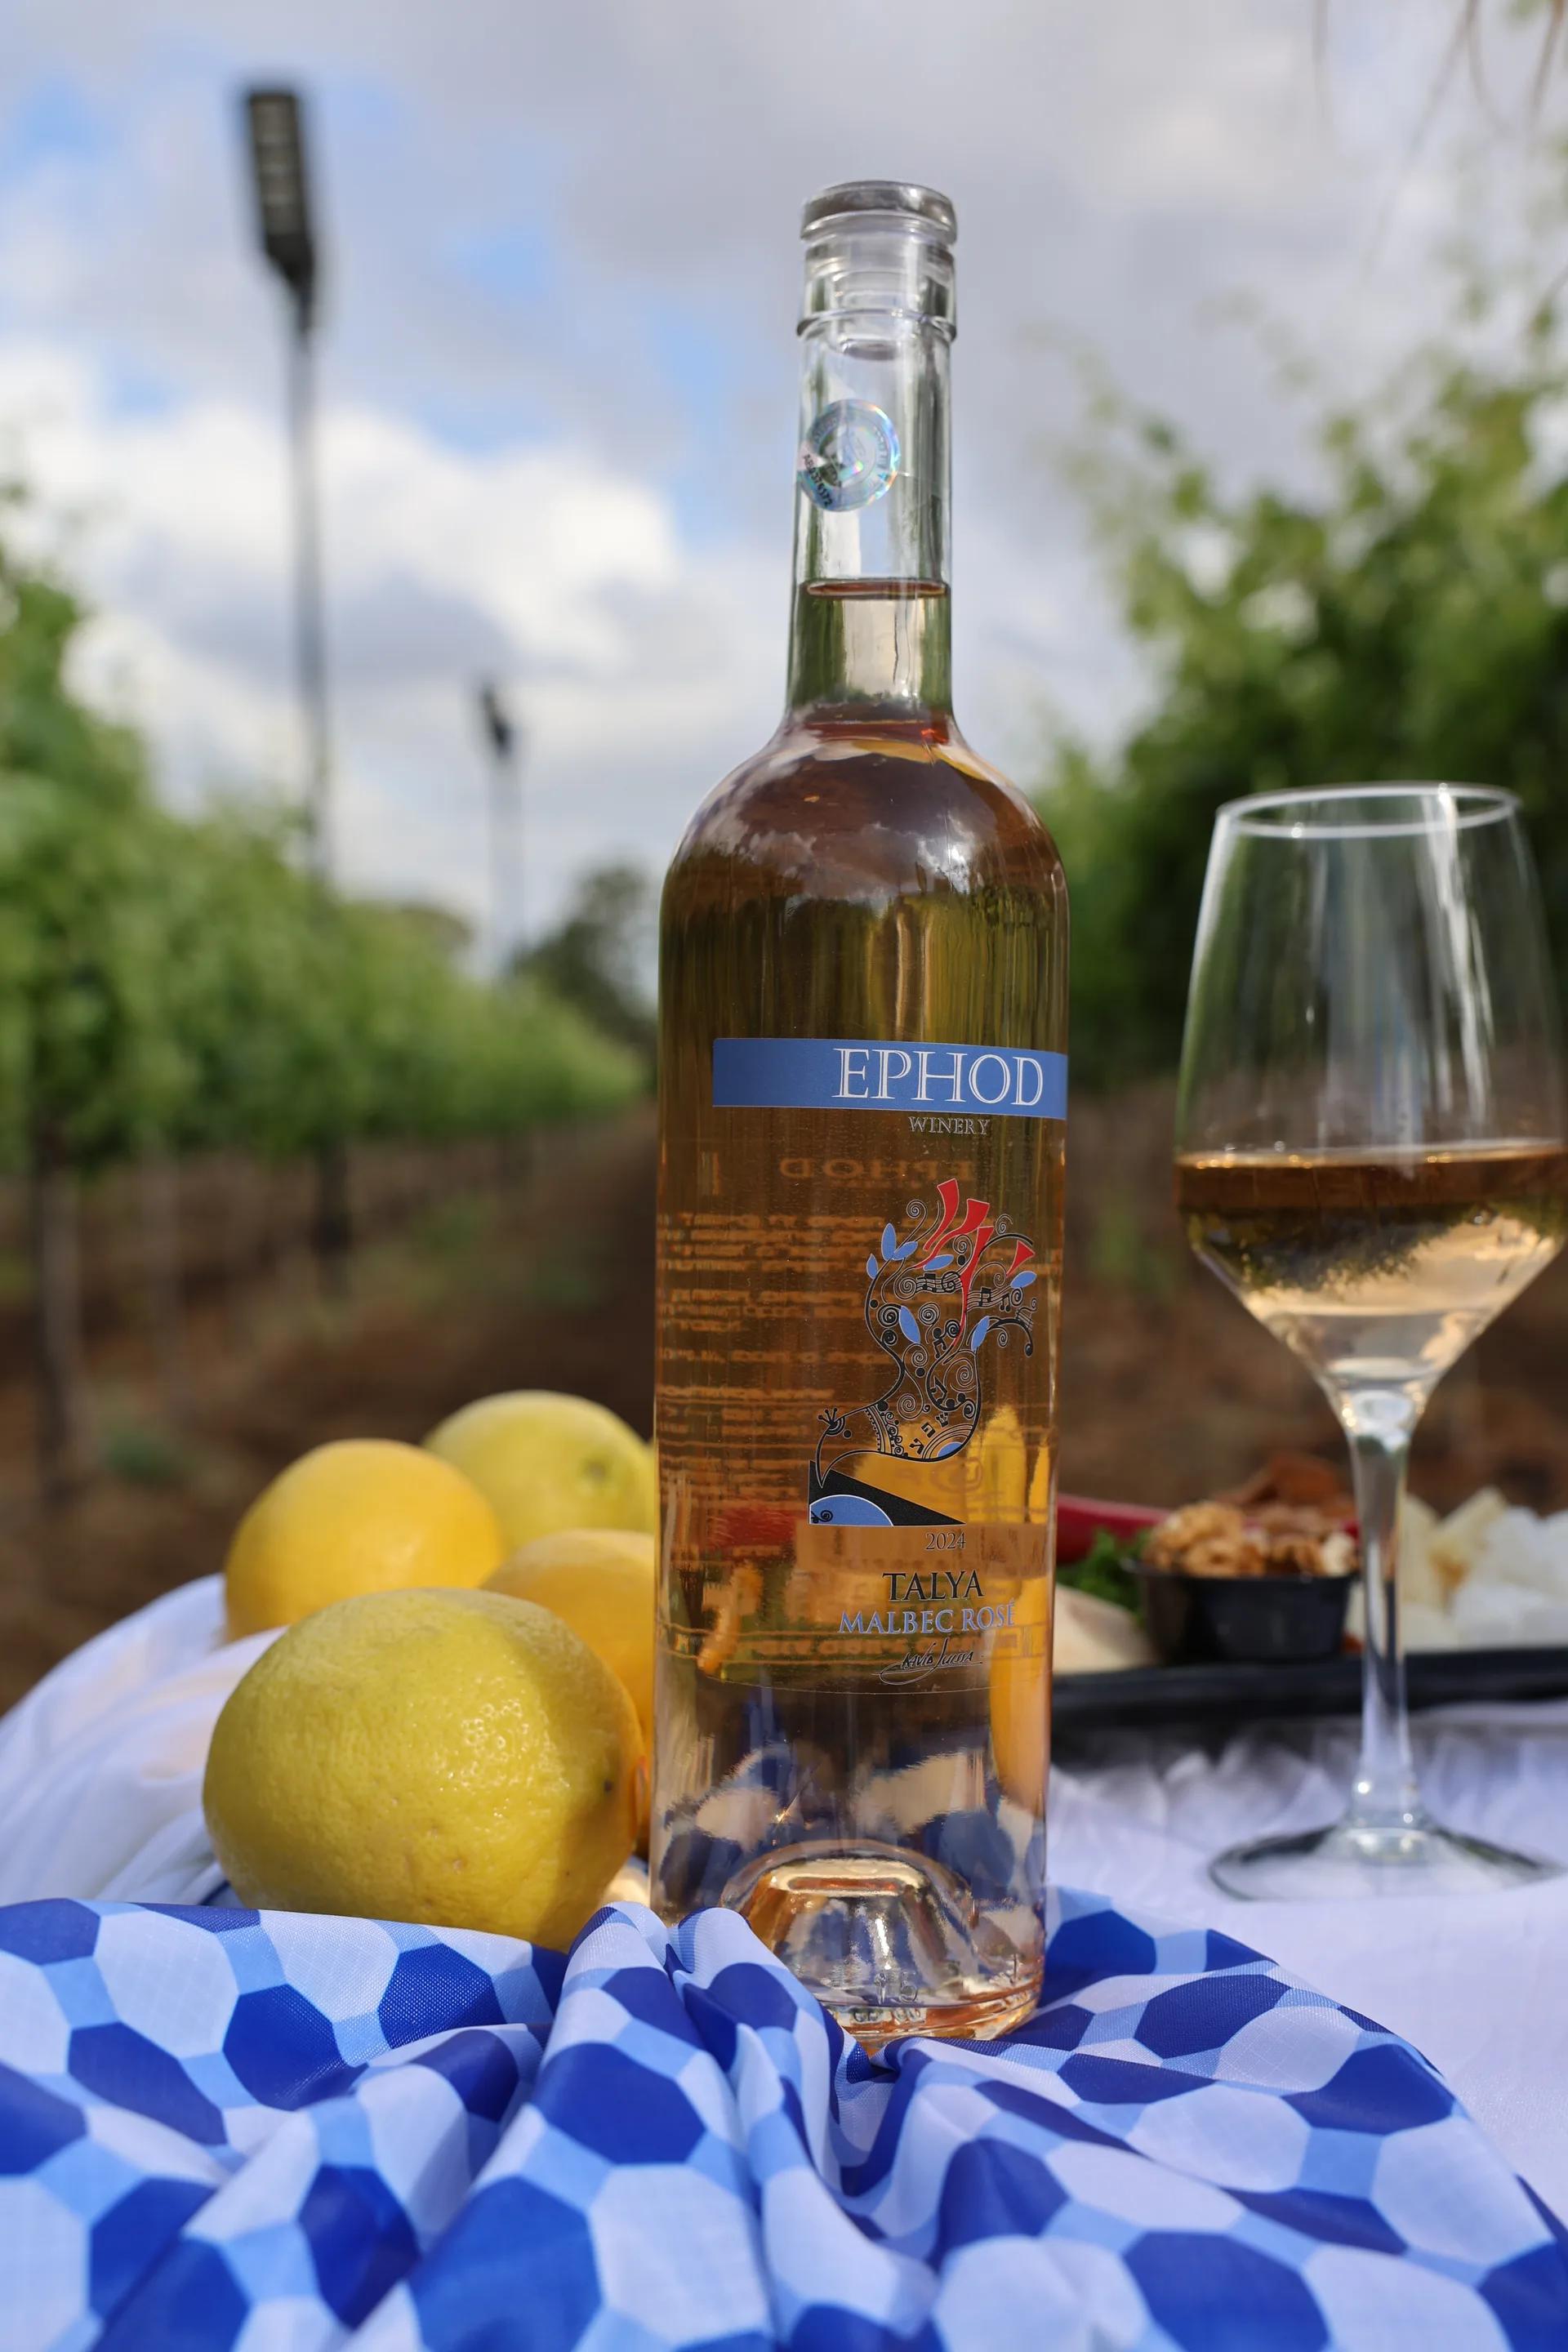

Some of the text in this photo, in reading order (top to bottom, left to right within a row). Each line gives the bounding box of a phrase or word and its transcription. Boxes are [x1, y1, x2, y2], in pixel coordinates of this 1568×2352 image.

[831, 1048, 1044, 1107] EPHOD
[908, 1116, 990, 1136] WINERY
[924, 1532, 967, 1551] 2024
[881, 1569, 986, 1602] TALYA
[837, 1597, 1017, 1635] MALBEC ROSÉ
